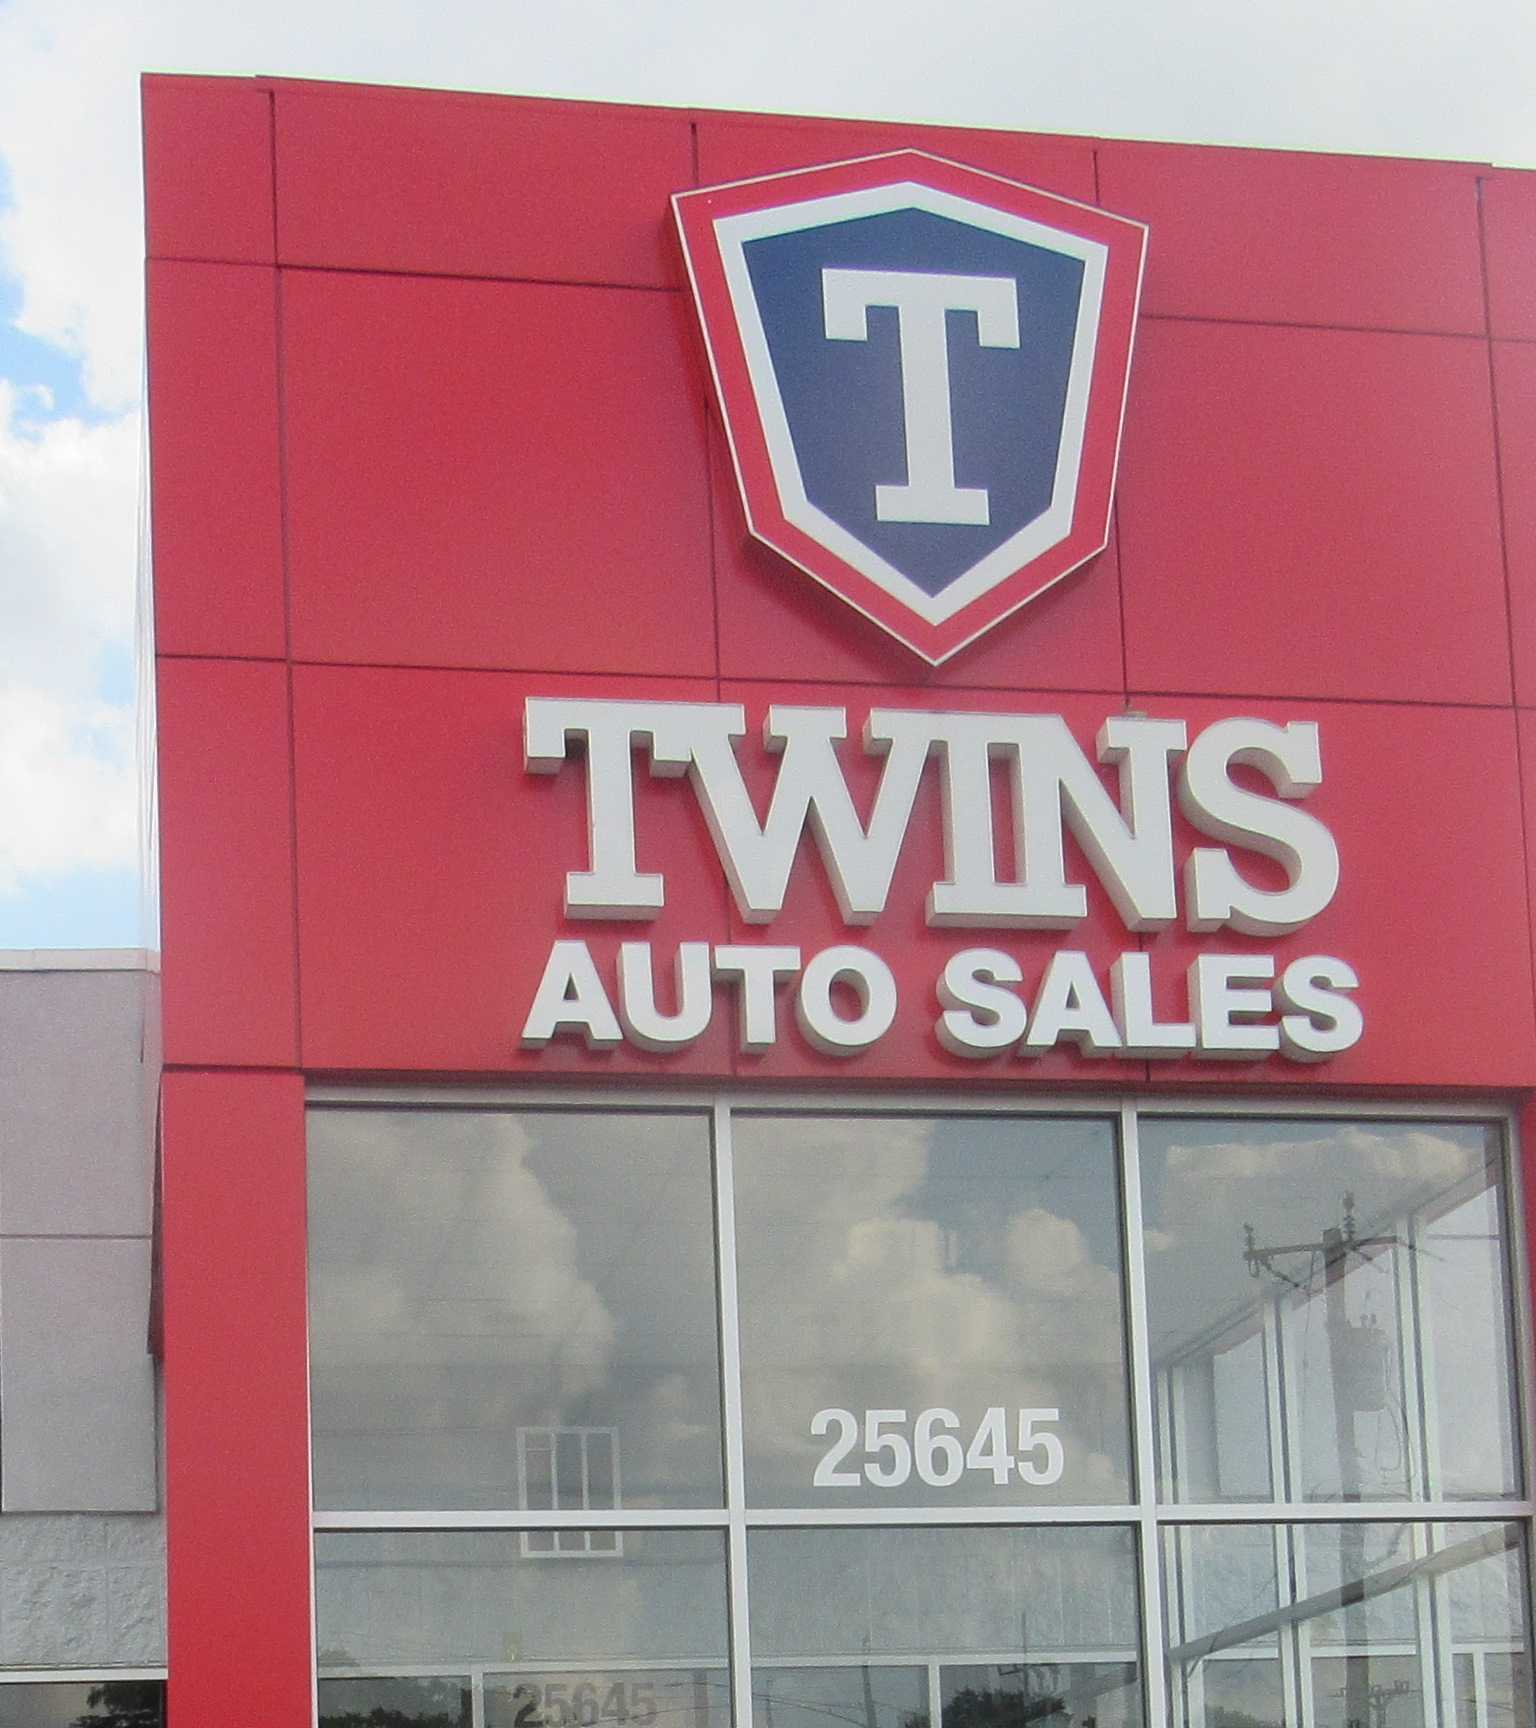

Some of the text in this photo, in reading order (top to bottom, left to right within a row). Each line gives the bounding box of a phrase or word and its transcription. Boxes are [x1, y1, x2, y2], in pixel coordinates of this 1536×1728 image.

[821, 267, 1021, 526] T
[523, 696, 1340, 937] TWINS
[520, 938, 1364, 1061] AUTO SALES
[810, 1407, 1065, 1488] 25645
[512, 1681, 659, 1728] 25645
